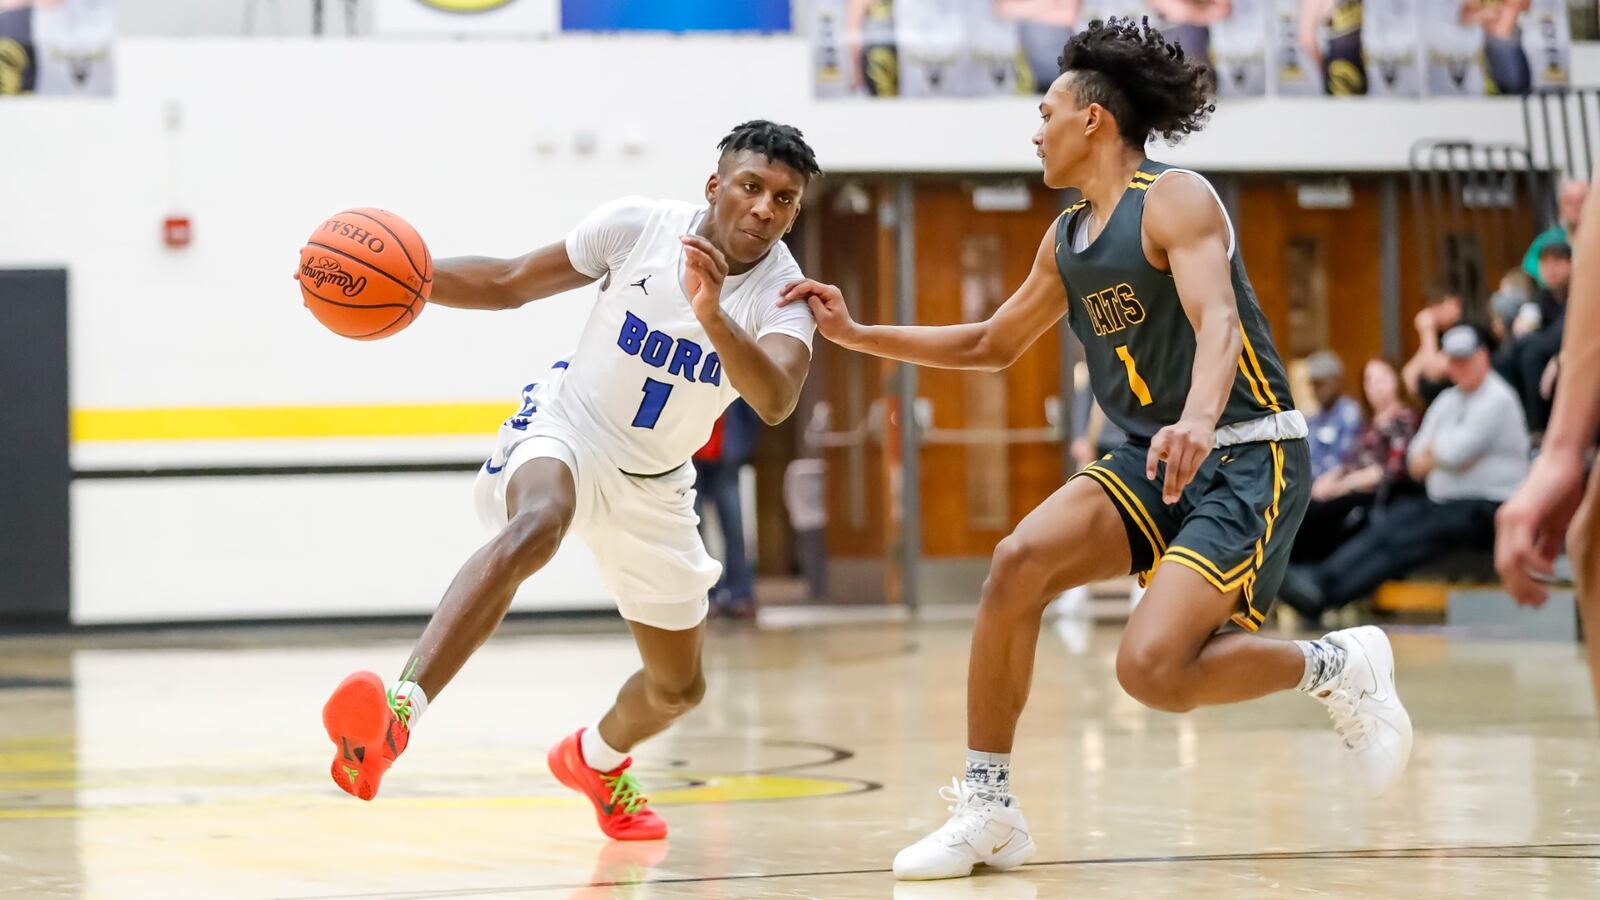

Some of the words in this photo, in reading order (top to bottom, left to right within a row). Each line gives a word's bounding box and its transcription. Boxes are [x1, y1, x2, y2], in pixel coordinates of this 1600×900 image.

[1081, 282, 1146, 337] ATS
[616, 310, 722, 387] BORO
[1115, 344, 1154, 407] 1
[631, 376, 674, 430] 1
